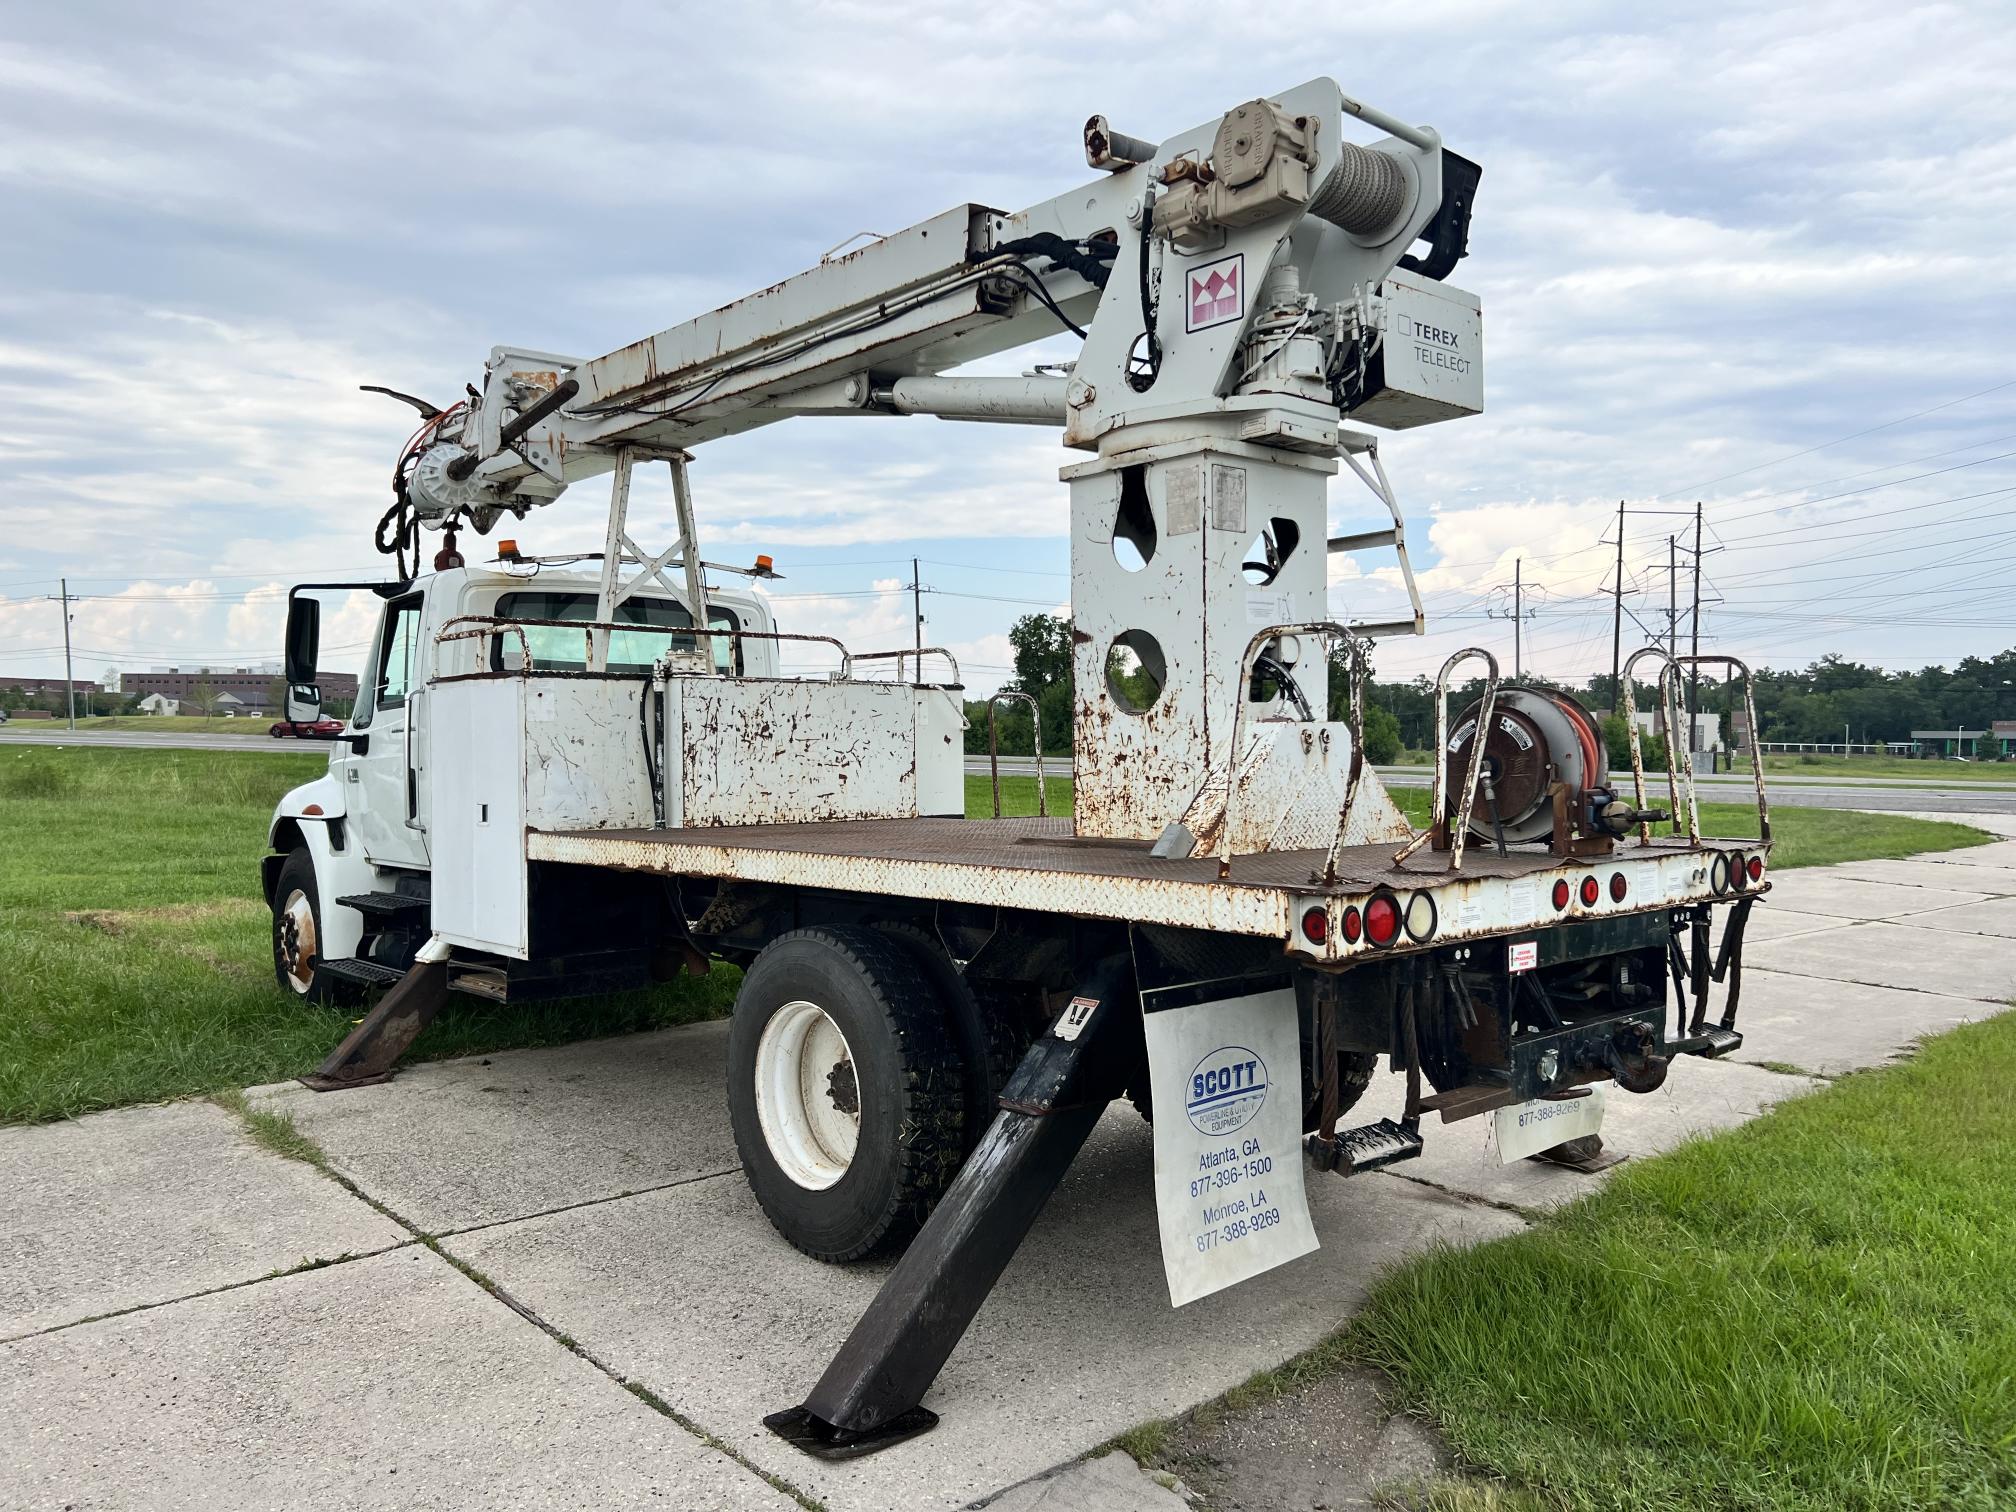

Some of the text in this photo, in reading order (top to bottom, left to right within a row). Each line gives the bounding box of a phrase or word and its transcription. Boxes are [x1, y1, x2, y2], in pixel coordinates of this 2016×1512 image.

[1254, 111, 1264, 166] BRADEN
[1414, 322, 1458, 348] TEREX
[1414, 346, 1471, 375] TELELECT
[1193, 1061, 1256, 1099] SCOTT
[1200, 1109, 1229, 1124] POWERLINE
[1211, 1115, 1242, 1131] EQUIPMENT
[1518, 1101, 1580, 1127] 877-388-9269
[1199, 1138, 1261, 1172] Atlanta, GA
[1191, 1156, 1272, 1198] 877-396-1500
[1203, 1189, 1267, 1226] Monroe, LA
[1196, 1208, 1280, 1252] 877-388-9269
